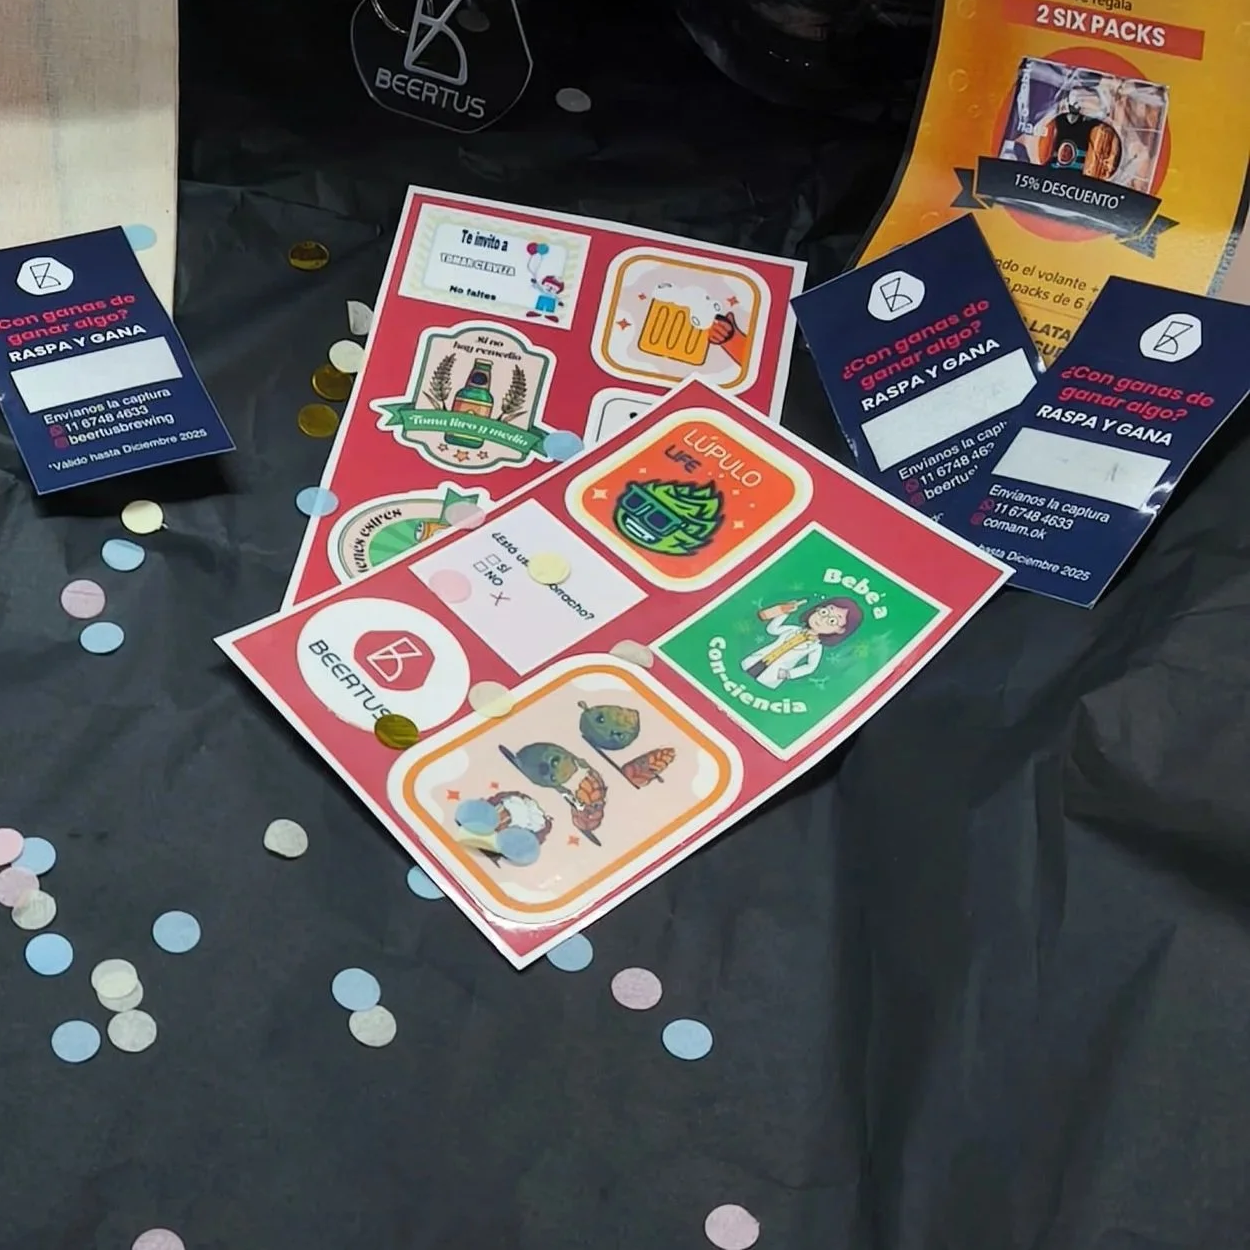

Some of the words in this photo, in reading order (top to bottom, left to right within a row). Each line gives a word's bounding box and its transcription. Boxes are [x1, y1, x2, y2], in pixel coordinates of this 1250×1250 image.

[1036, 4, 1050, 24] 2
[1053, 8, 1087, 31] SIX
[1091, 15, 1166, 47] PACKS
[375, 67, 486, 119] BEERTUS
[1015, 174, 1040, 190] 15%
[461, 229, 473, 244] Te
[474, 231, 501, 250] invito
[501, 240, 509, 252] a
[1022, 265, 1036, 277] el
[1038, 270, 1087, 291] volante
[449, 285, 464, 294] No
[467, 288, 497, 301] faltes
[1011, 283, 1050, 300] packs
[1053, 293, 1070, 306] de
[1074, 297, 1085, 310] 6
[41, 300, 108, 323] ganas
[110, 293, 137, 307] de
[7, 322, 71, 347] ganar
[74, 308, 130, 330] algo?
[841, 347, 892, 381] ¿Con
[894, 314, 960, 354] ganas
[963, 299, 990, 319] de
[8, 341, 73, 363] RASPA
[71, 336, 88, 348] Y
[90, 323, 147, 344] GANA
[453, 341, 474, 353] hay
[475, 347, 522, 361] remedio
[490, 339, 504, 347] no
[859, 351, 923, 391] ganar
[927, 320, 983, 358] algo?
[861, 377, 925, 412] RASPA
[926, 365, 940, 379] Y
[942, 338, 1000, 371] GANA
[1061, 365, 1115, 385] ¿Con
[1115, 378, 1184, 402] ganas
[1185, 392, 1215, 408] de
[106, 399, 120, 410] la
[122, 387, 171, 408] captura
[1058, 385, 1126, 410] ganar
[1129, 399, 1188, 421] algo?
[65, 421, 80, 433] 11
[81, 412, 115, 429] 6748
[116, 405, 149, 421] 4633
[68, 412, 174, 445] beertusbrewing
[1036, 405, 1099, 429] RASPA
[1101, 419, 1117, 432] Y
[1117, 422, 1173, 447] GANA
[89, 446, 121, 463] hasta
[123, 436, 178, 454] Diciembre
[179, 429, 208, 443] 2025
[489, 429, 528, 447] medio
[961, 438, 975, 450] la
[664, 444, 702, 473] LIFE
[683, 429, 762, 487] LÚPULO
[920, 473, 934, 485] 11
[936, 455, 970, 478] 6748
[995, 502, 1008, 513] 11
[1008, 506, 1042, 522] 6748
[1041, 513, 1074, 530] 4633
[1049, 497, 1062, 510] la
[1063, 501, 1111, 525] captura
[982, 515, 1047, 541] comam.ok
[484, 571, 503, 586] NO
[1006, 551, 1060, 572] Diciembre
[1060, 565, 1091, 581] 2025
[872, 606, 888, 619] a
